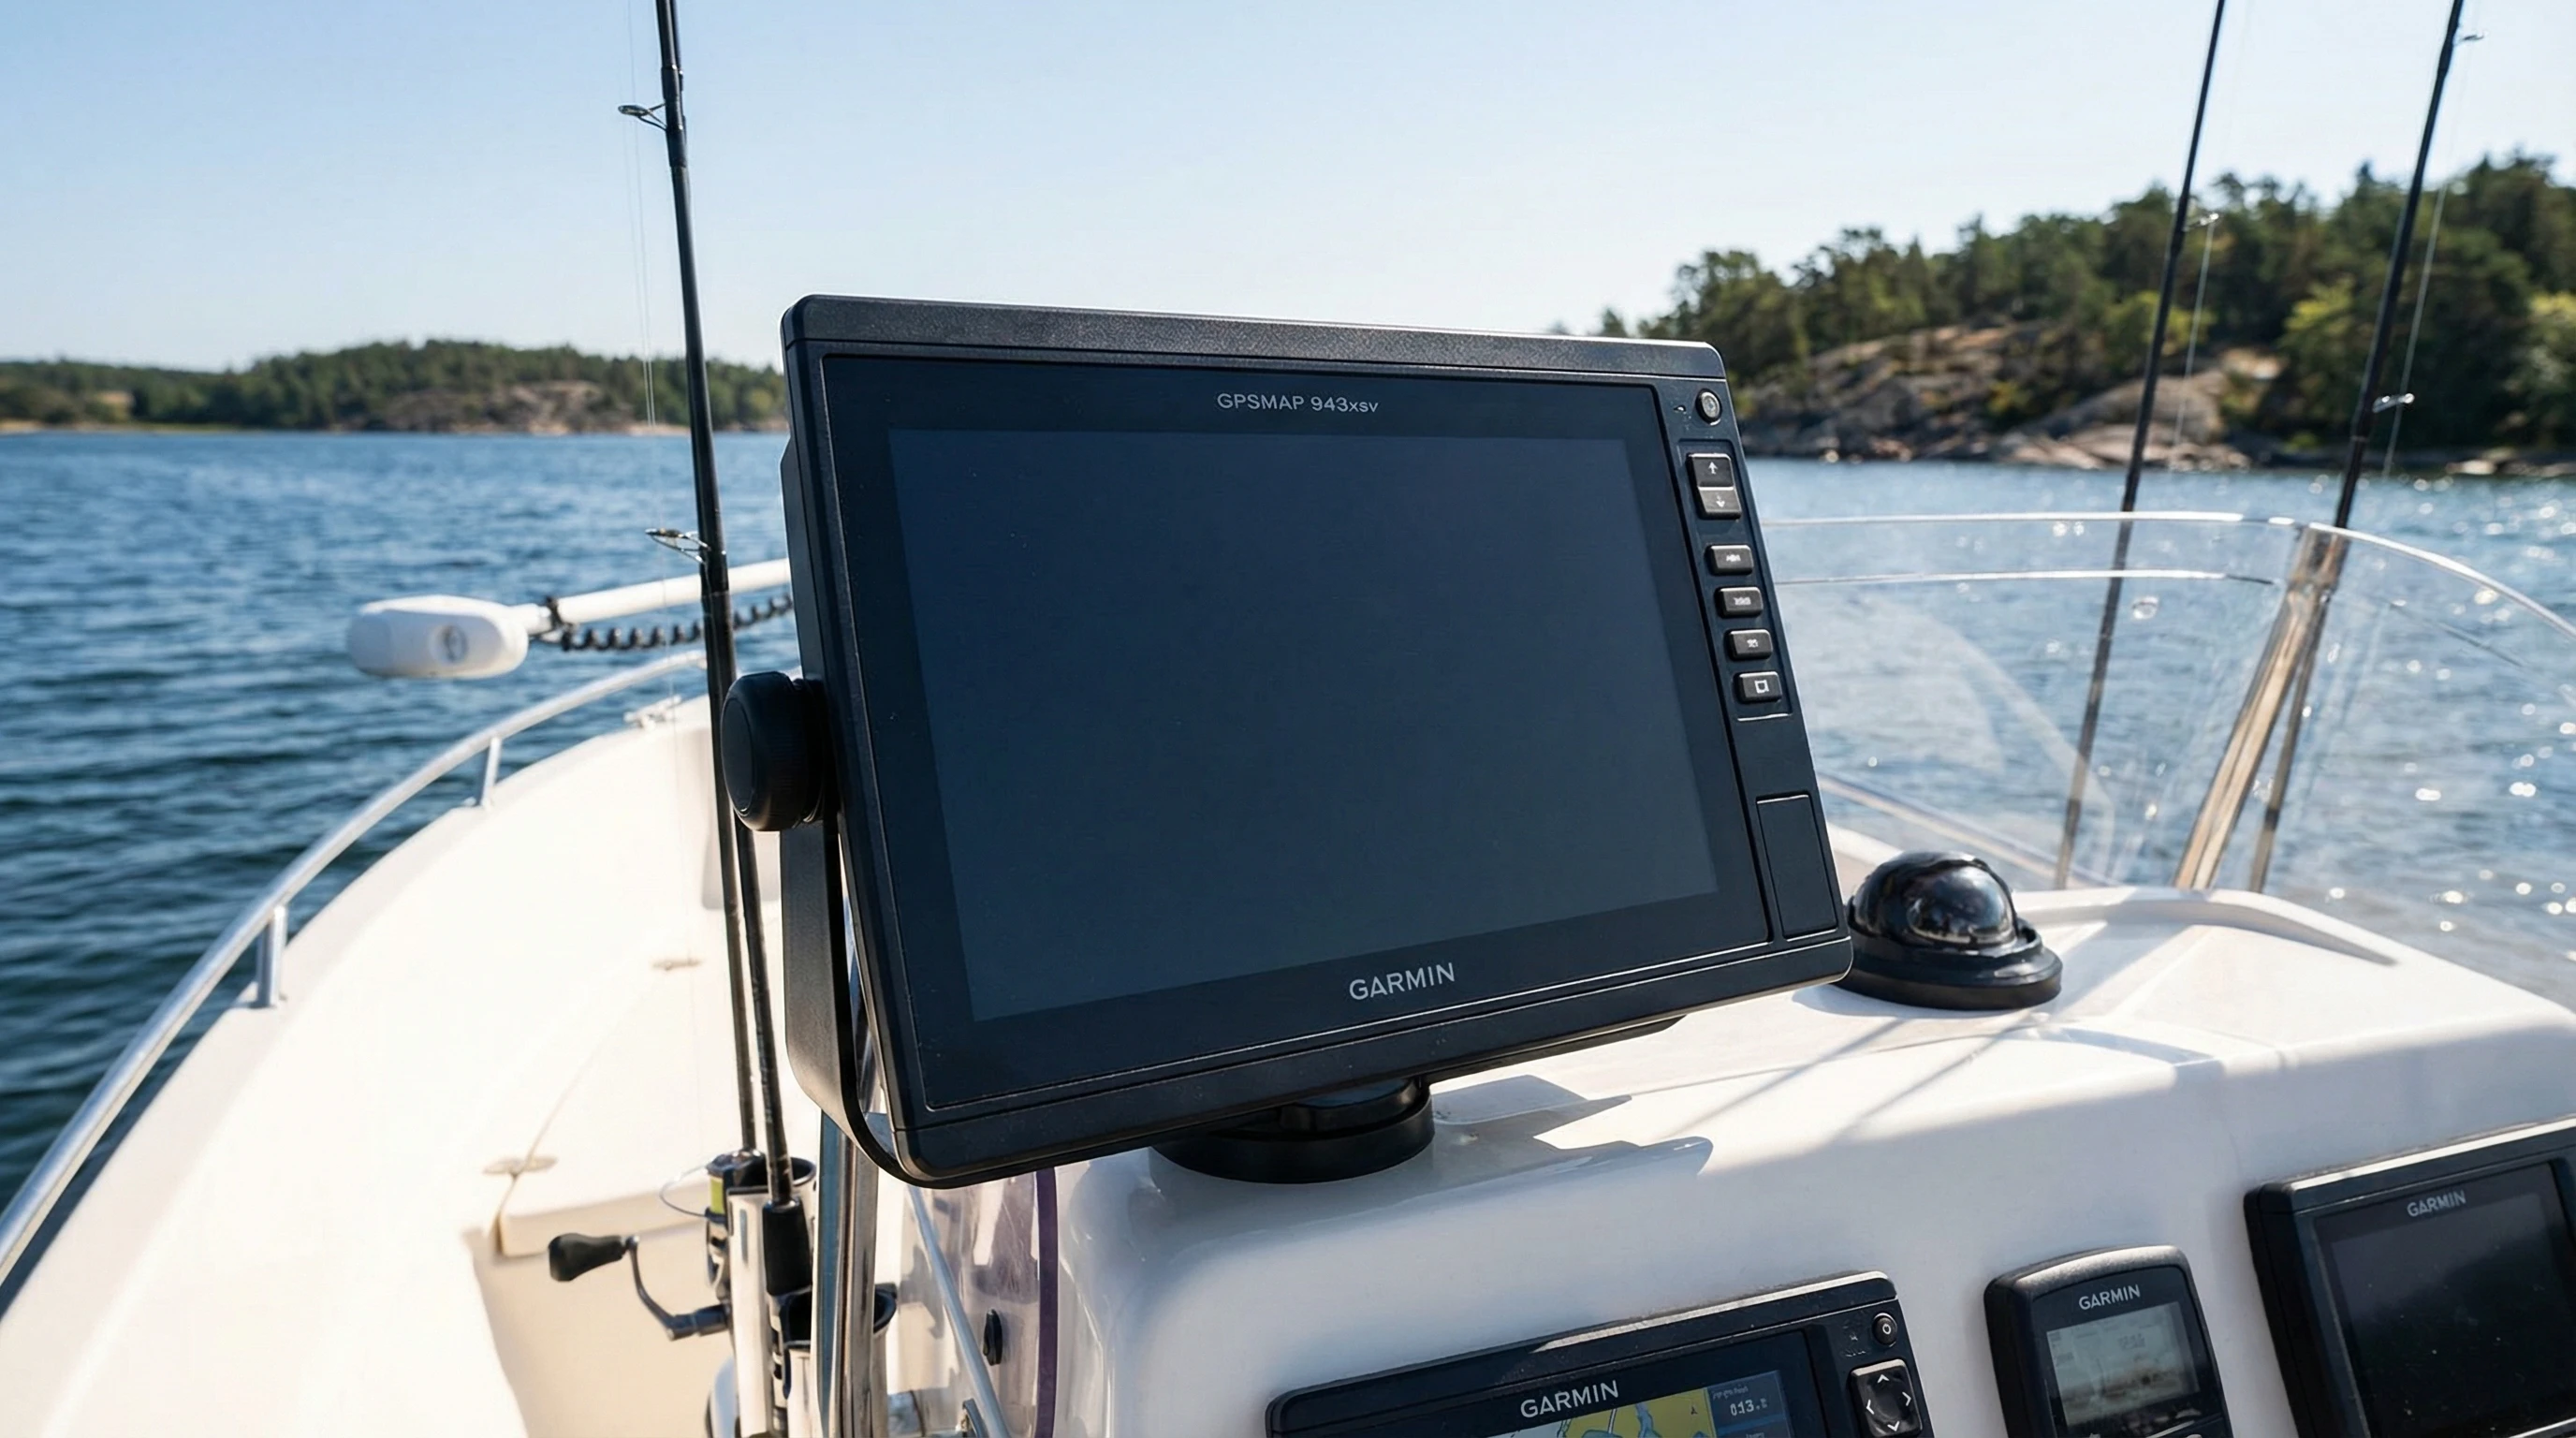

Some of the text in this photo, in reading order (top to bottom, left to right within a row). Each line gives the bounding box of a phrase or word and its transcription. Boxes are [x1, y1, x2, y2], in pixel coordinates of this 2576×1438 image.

[1217, 393, 1378, 413] GPSMAP 943xsv
[1349, 962, 1455, 1000] GARMIN
[2407, 1189, 2466, 1217] GARMIN
[2078, 1284, 2141, 1310] GARMIN
[1520, 1379, 1618, 1418] GARMIN
